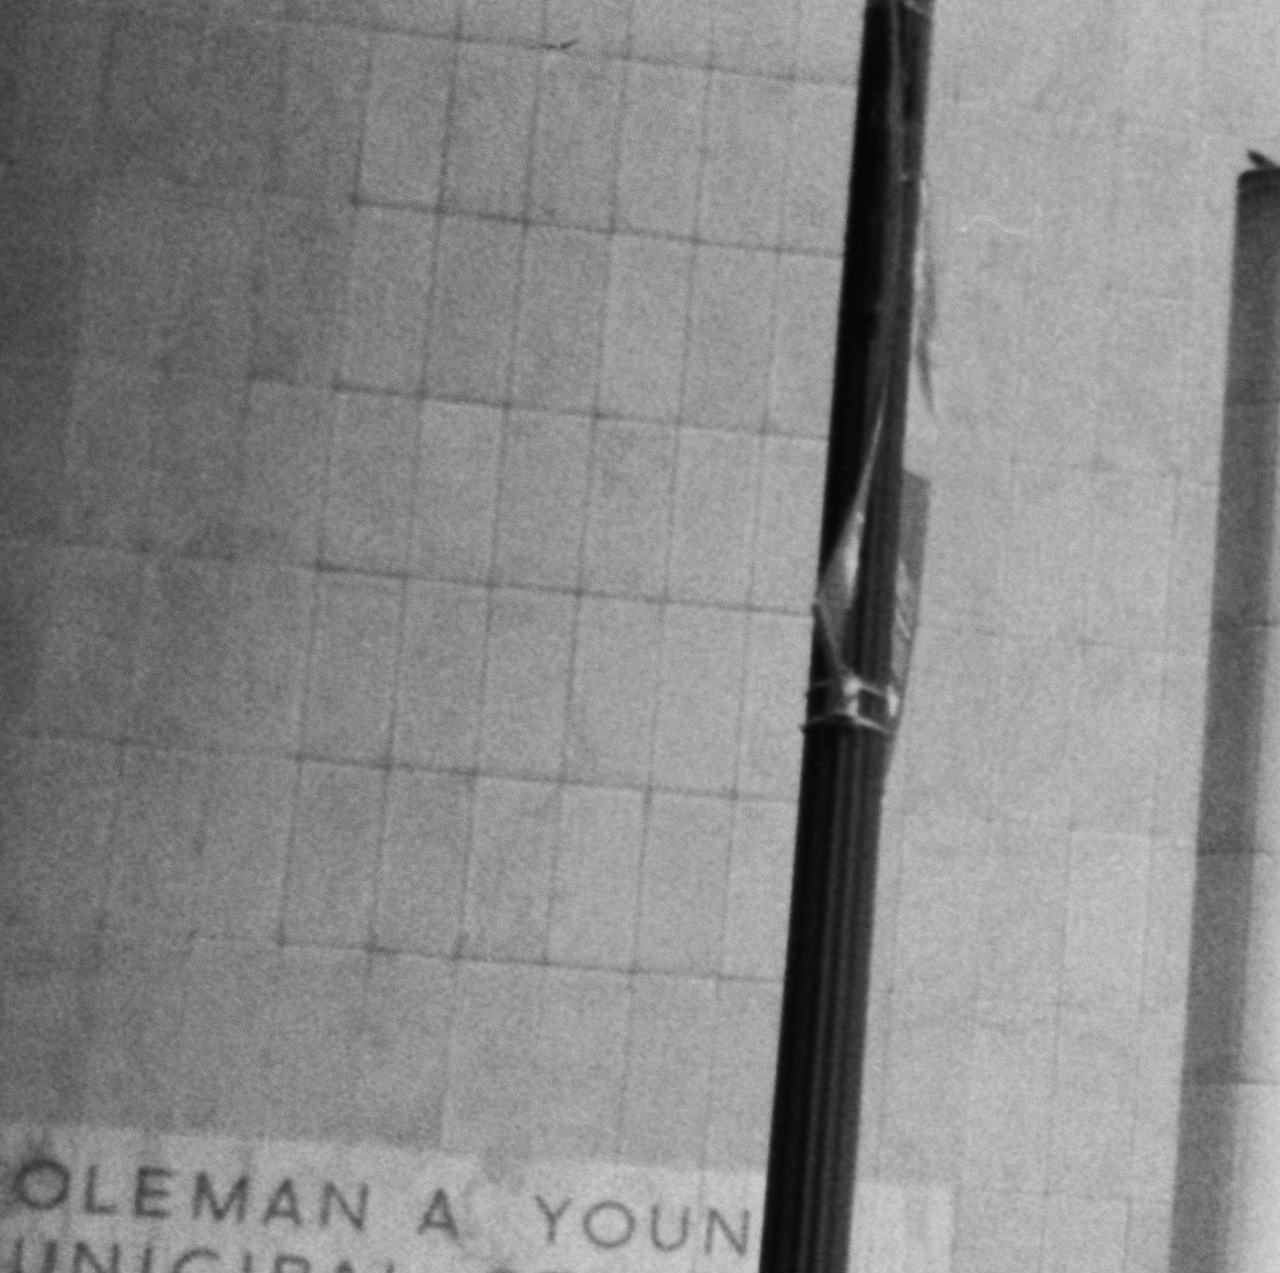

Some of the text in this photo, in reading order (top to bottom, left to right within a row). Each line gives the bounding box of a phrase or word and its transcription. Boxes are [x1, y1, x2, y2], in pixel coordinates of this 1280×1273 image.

[12, 1157, 750, 1257] OLEMAN A YOUN
